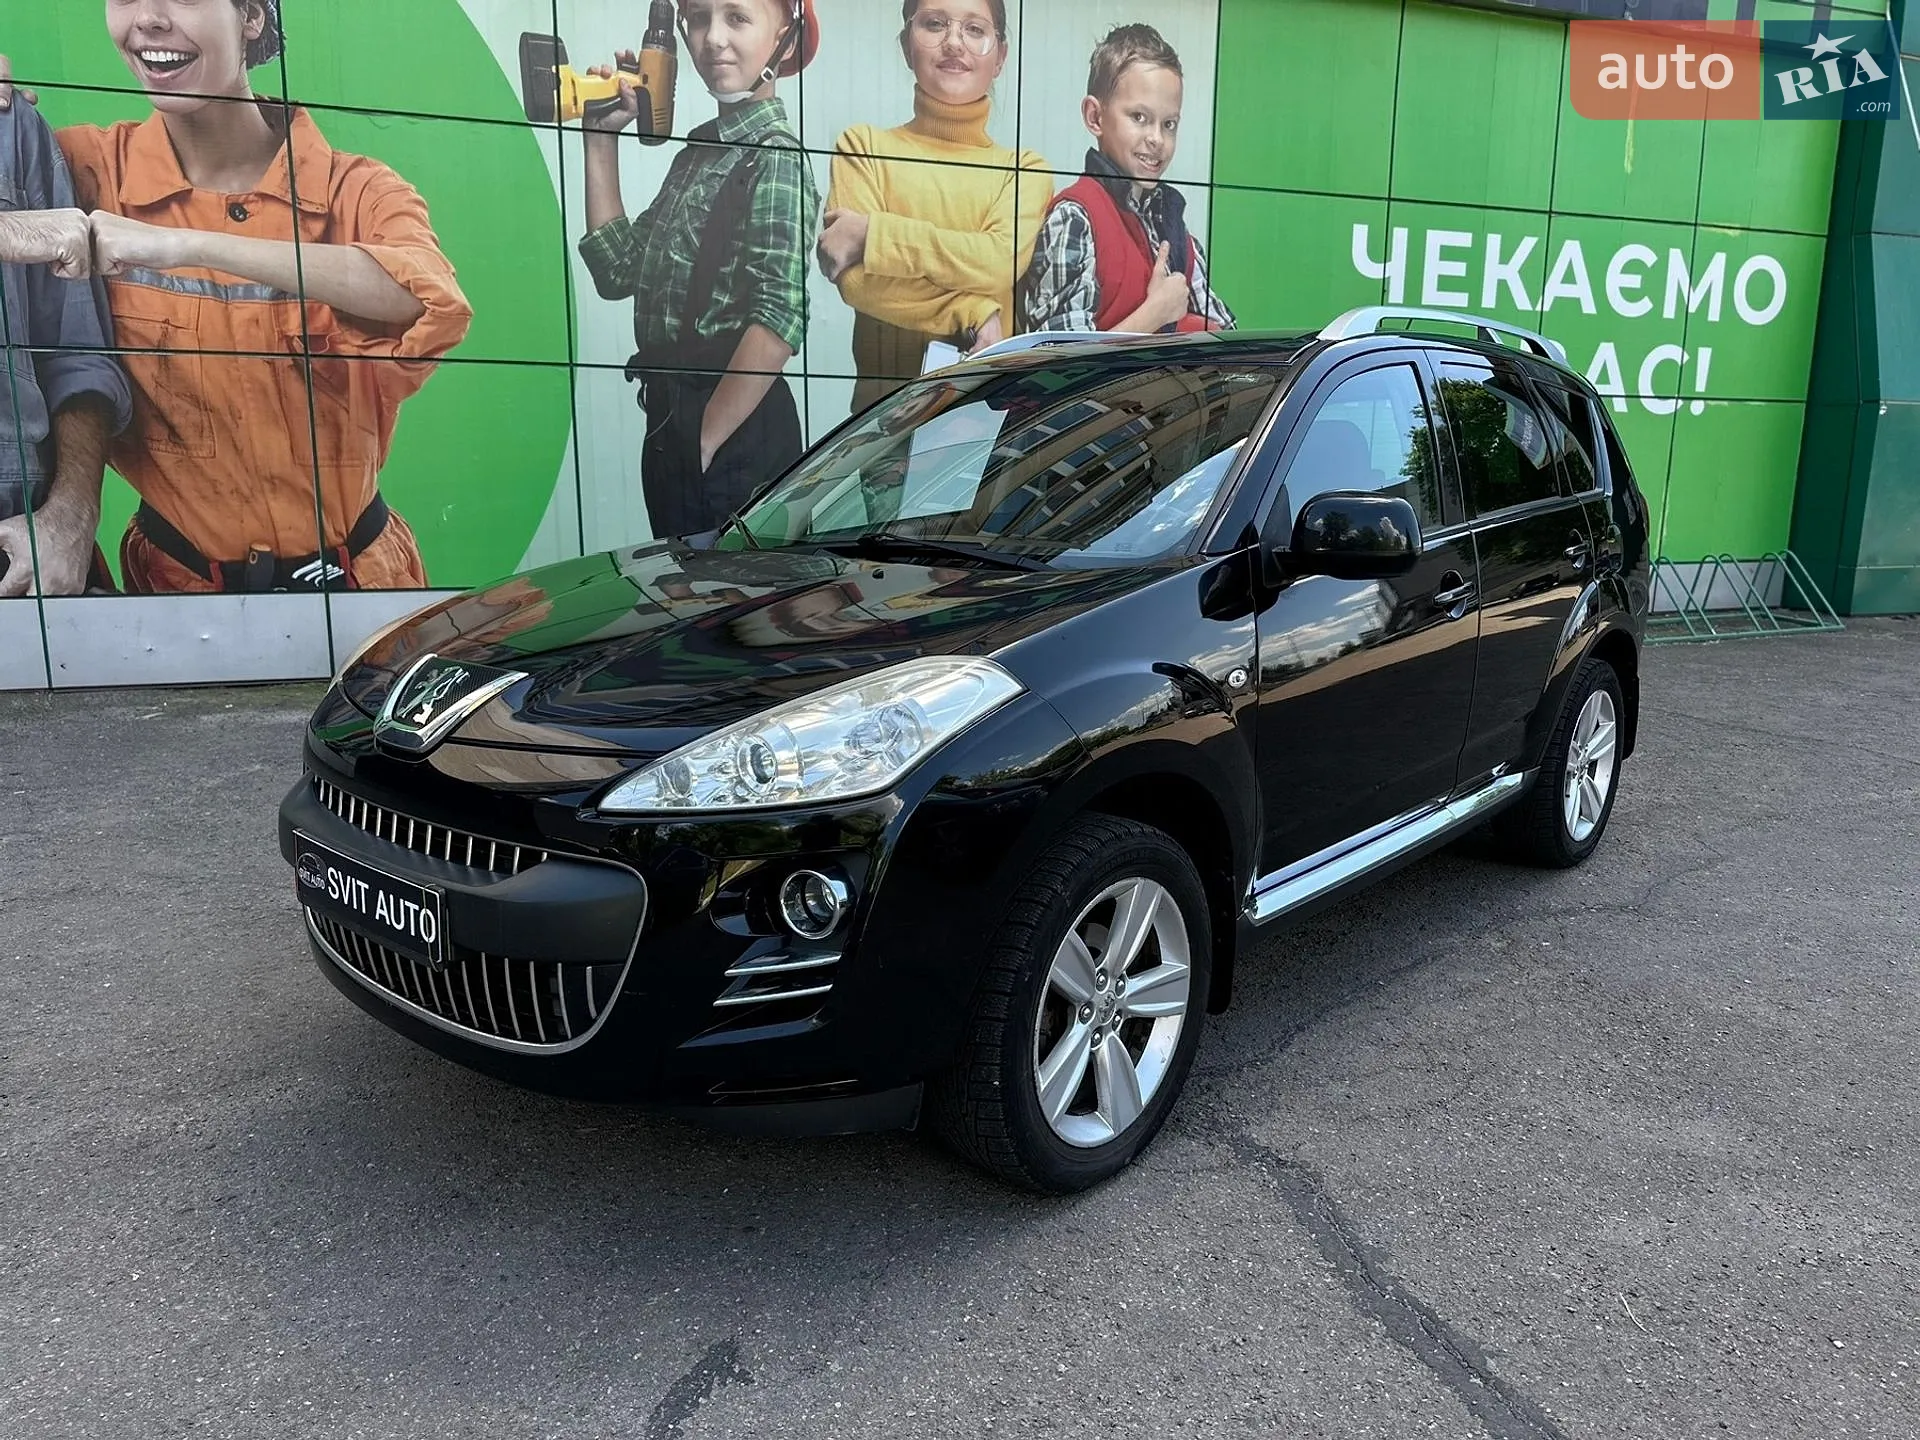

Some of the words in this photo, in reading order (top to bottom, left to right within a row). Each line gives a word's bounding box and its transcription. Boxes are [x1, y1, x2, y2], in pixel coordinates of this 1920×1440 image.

[1351, 223, 1787, 326] ЧЕКАЄМО
[1520, 339, 1713, 417] АС!
[327, 866, 369, 914] SVIT
[375, 889, 436, 944] AUTO
